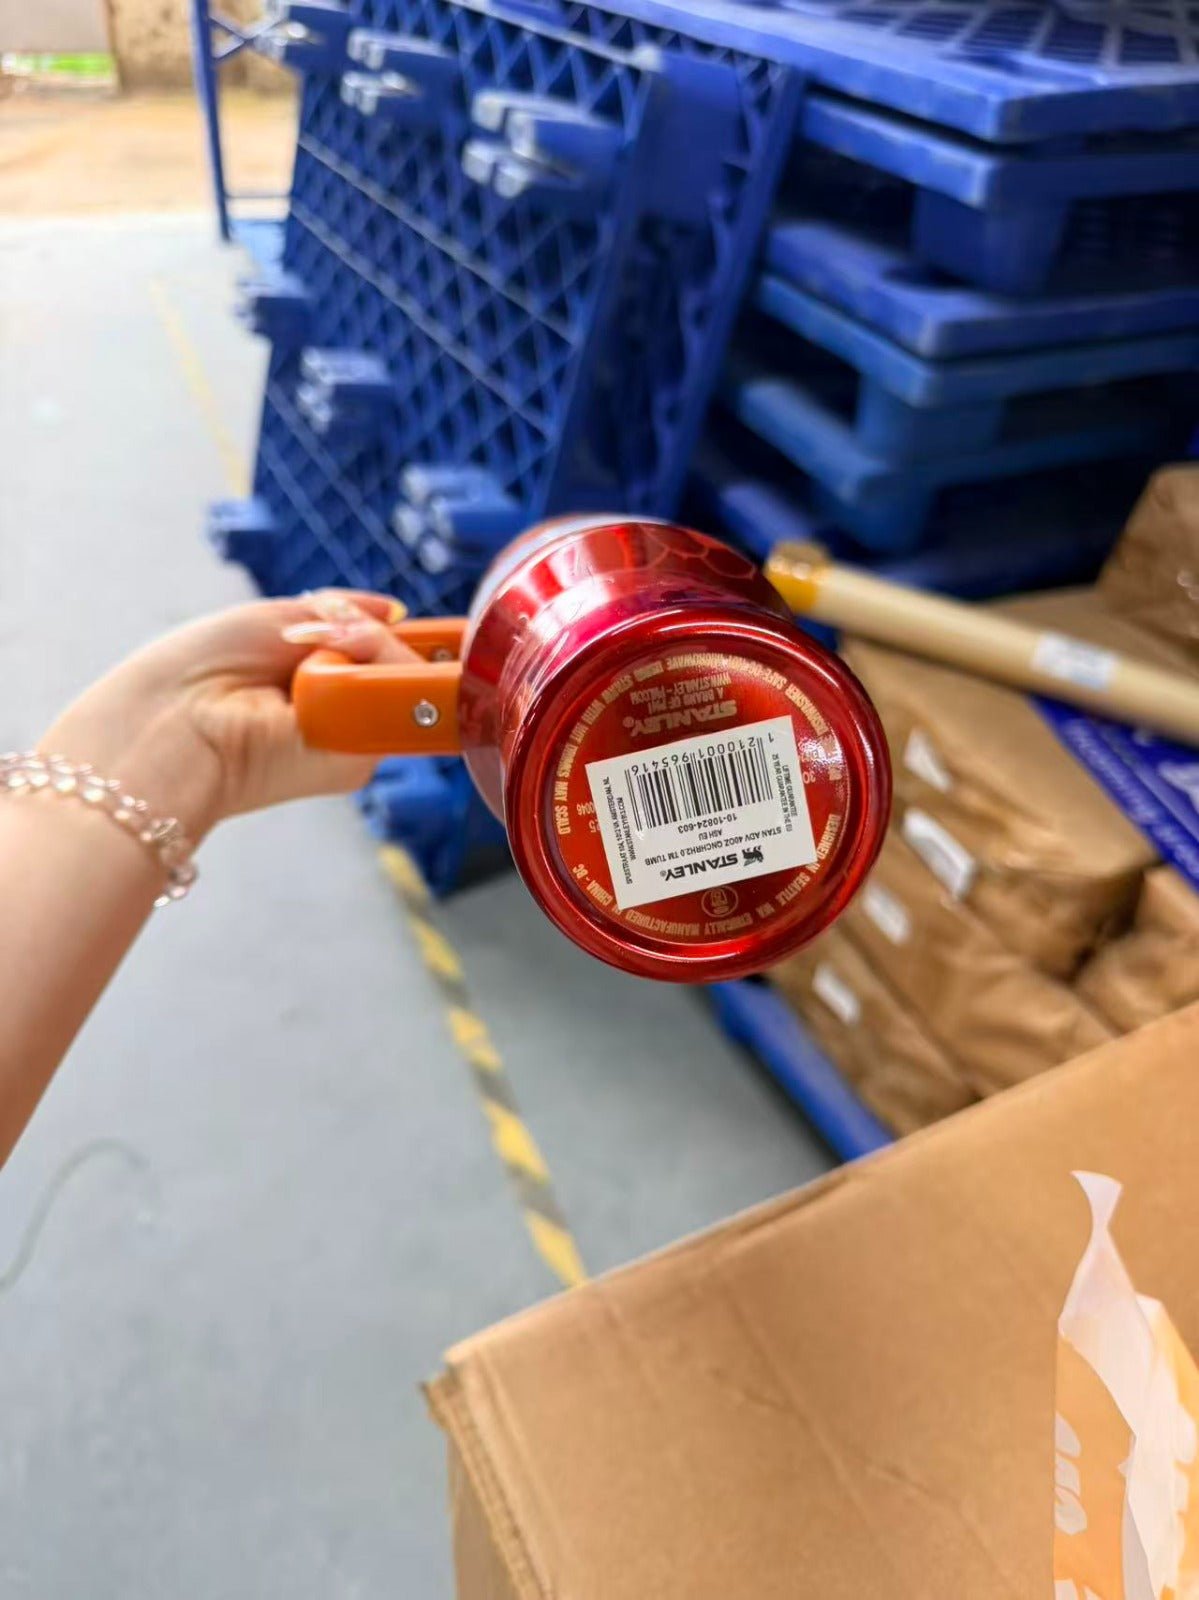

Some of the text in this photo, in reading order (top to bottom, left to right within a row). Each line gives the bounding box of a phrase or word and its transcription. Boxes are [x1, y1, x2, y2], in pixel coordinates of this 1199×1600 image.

[631, 700, 738, 737] STANLEY
[785, 683, 828, 737] DISHWASHER
[631, 732, 774, 776] 1 210001 965416
[554, 781, 568, 801] MAY
[554, 805, 571, 835] SCALD
[677, 812, 738, 834] 10-10824-603
[698, 829, 723, 841] ASH EU
[744, 830, 761, 842] ADV
[762, 826, 782, 838] STAN
[645, 855, 667, 866] TUMB
[667, 851, 680, 860] TM
[572, 863, 588, 879] BC
[665, 853, 739, 881] STANLEY
[775, 871, 811, 907] SEATTLE
[625, 909, 700, 936] MANUFACTURED
